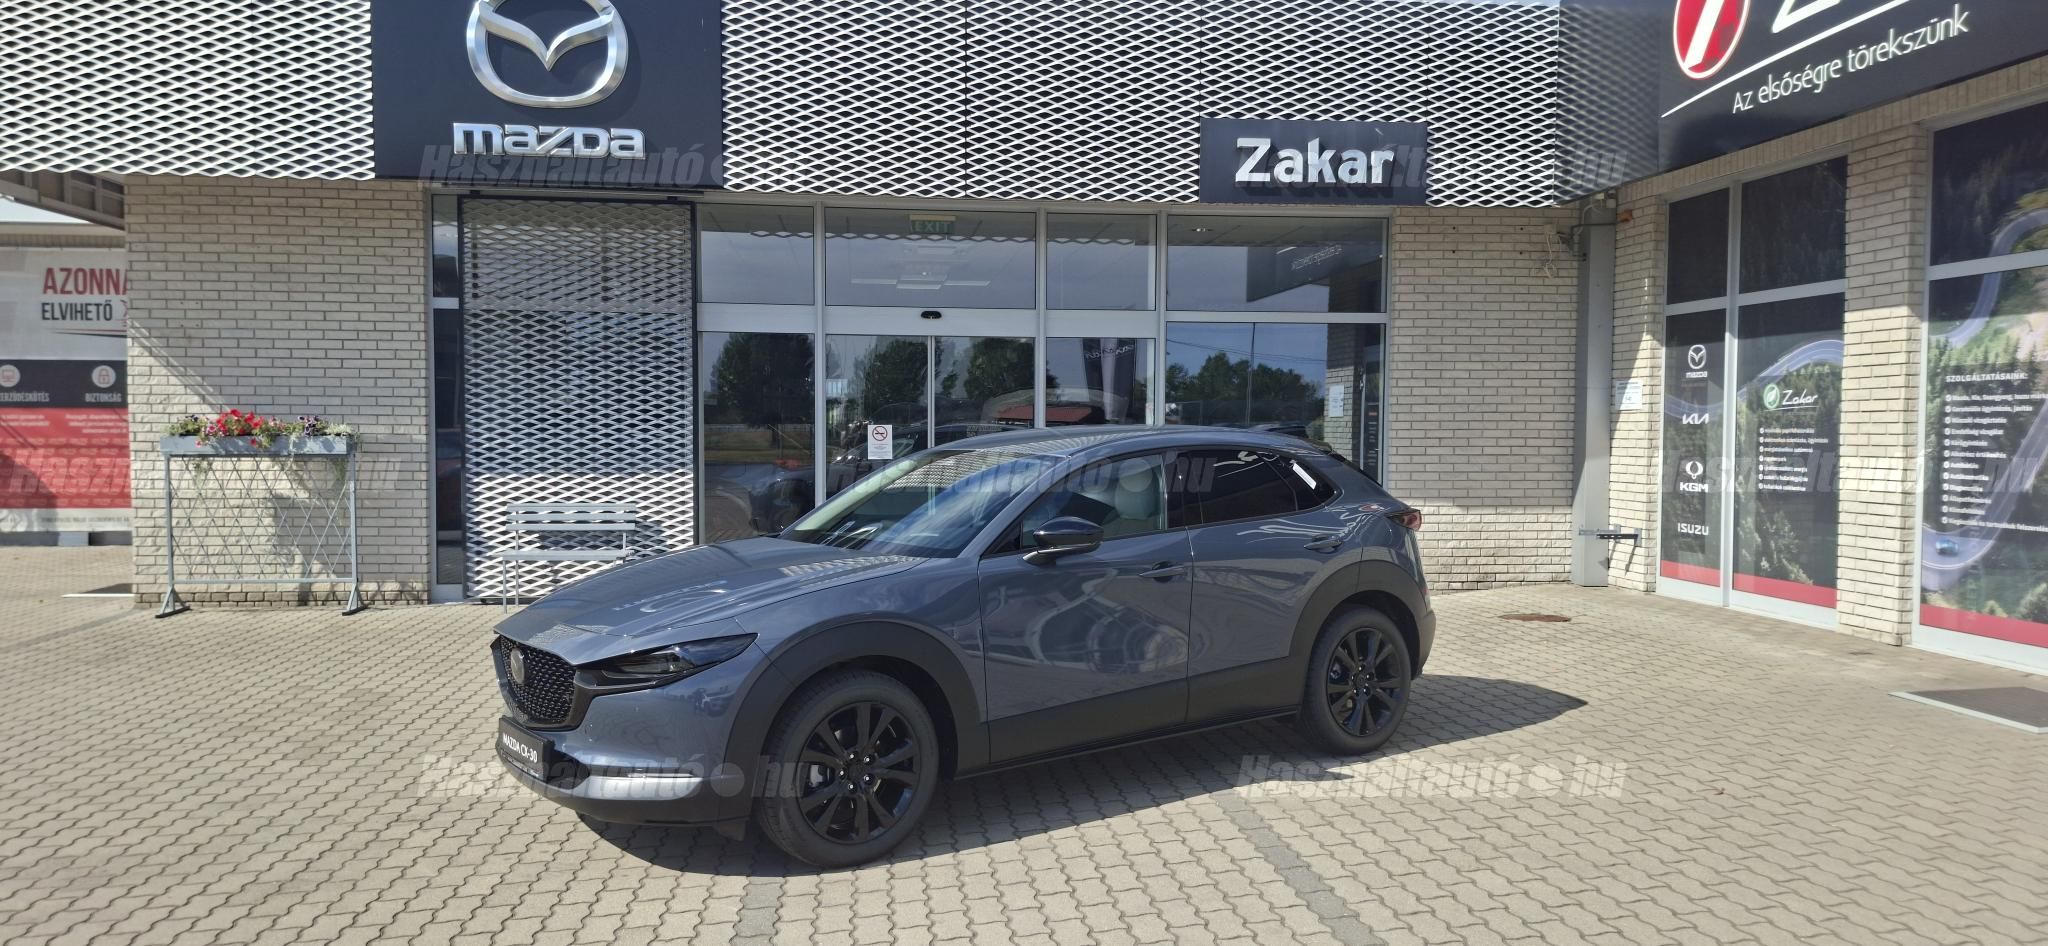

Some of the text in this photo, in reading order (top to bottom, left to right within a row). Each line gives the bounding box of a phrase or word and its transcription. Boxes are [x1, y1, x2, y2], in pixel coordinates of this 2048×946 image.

[1732, 91, 1754, 113] Az
[1758, 58, 1843, 104] elsőségre
[1847, 3, 1971, 73] törekszünk
[1235, 136, 1395, 184] Zakar
[914, 220, 951, 232] EXIT
[41, 300, 113, 321] ELVIHETŐ
[1782, 388, 1819, 406] Zakar
[1679, 482, 1709, 493] KGM
[1677, 523, 1709, 536] ISUZU
[502, 733, 538, 764] MAZDA CX-30
